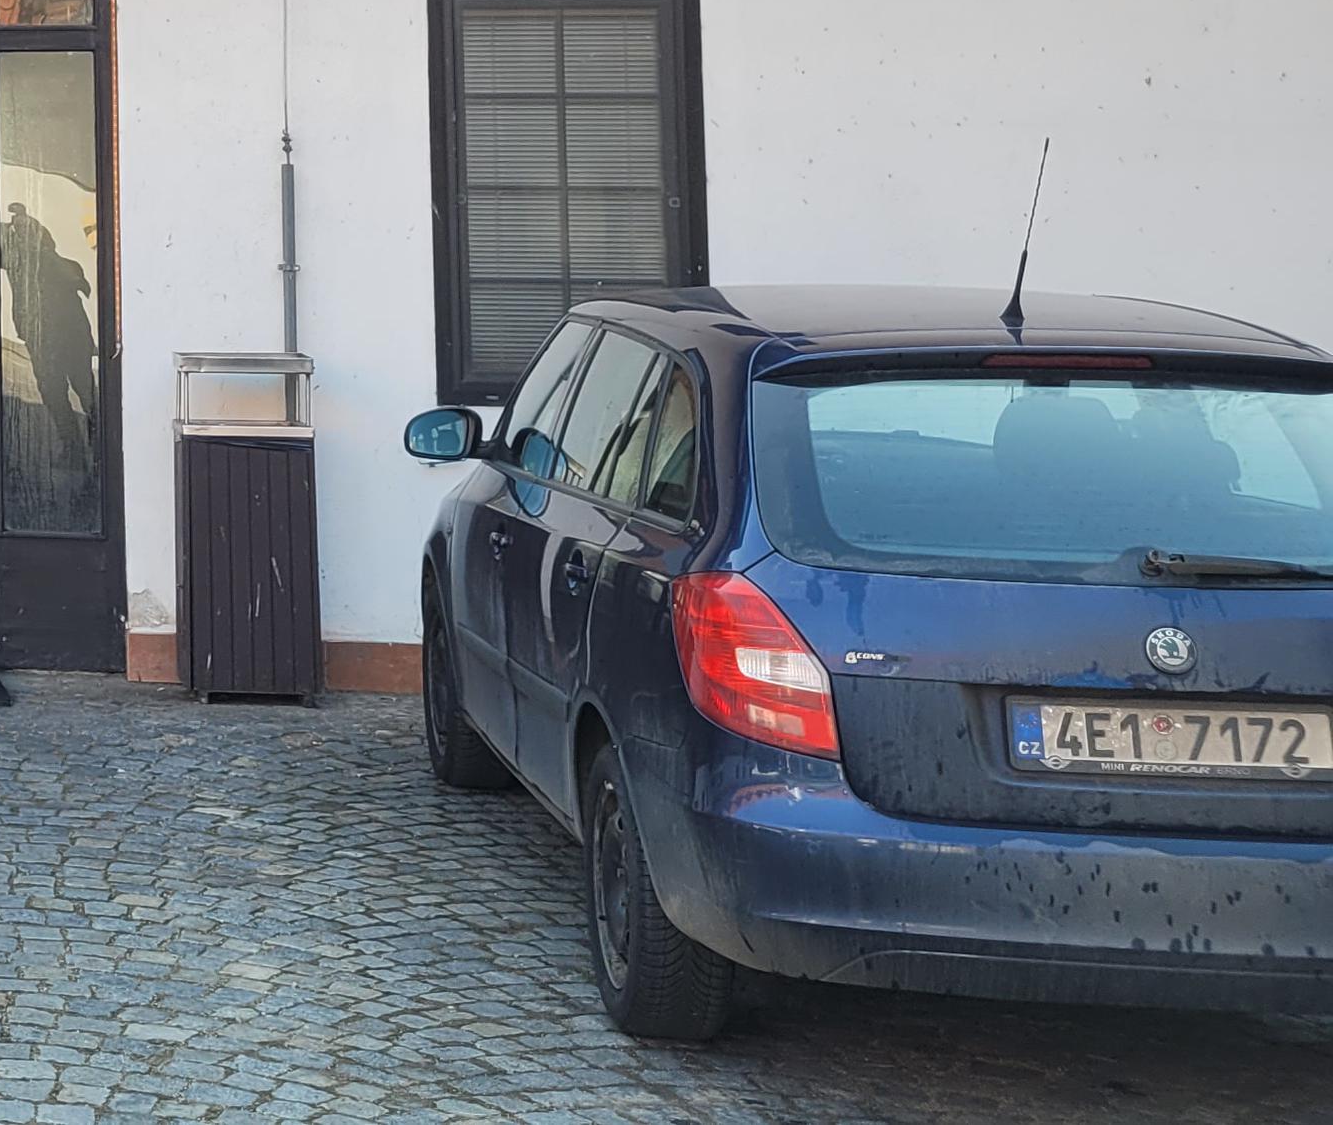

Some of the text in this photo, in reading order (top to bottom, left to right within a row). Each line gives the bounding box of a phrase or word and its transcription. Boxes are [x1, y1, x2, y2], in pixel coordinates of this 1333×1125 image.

[1055, 712, 1310, 764] 4E1 7172
[1018, 741, 1042, 755] CZ
[1101, 762, 1125, 772] MINI
[1129, 763, 1211, 775] RENOCAR
